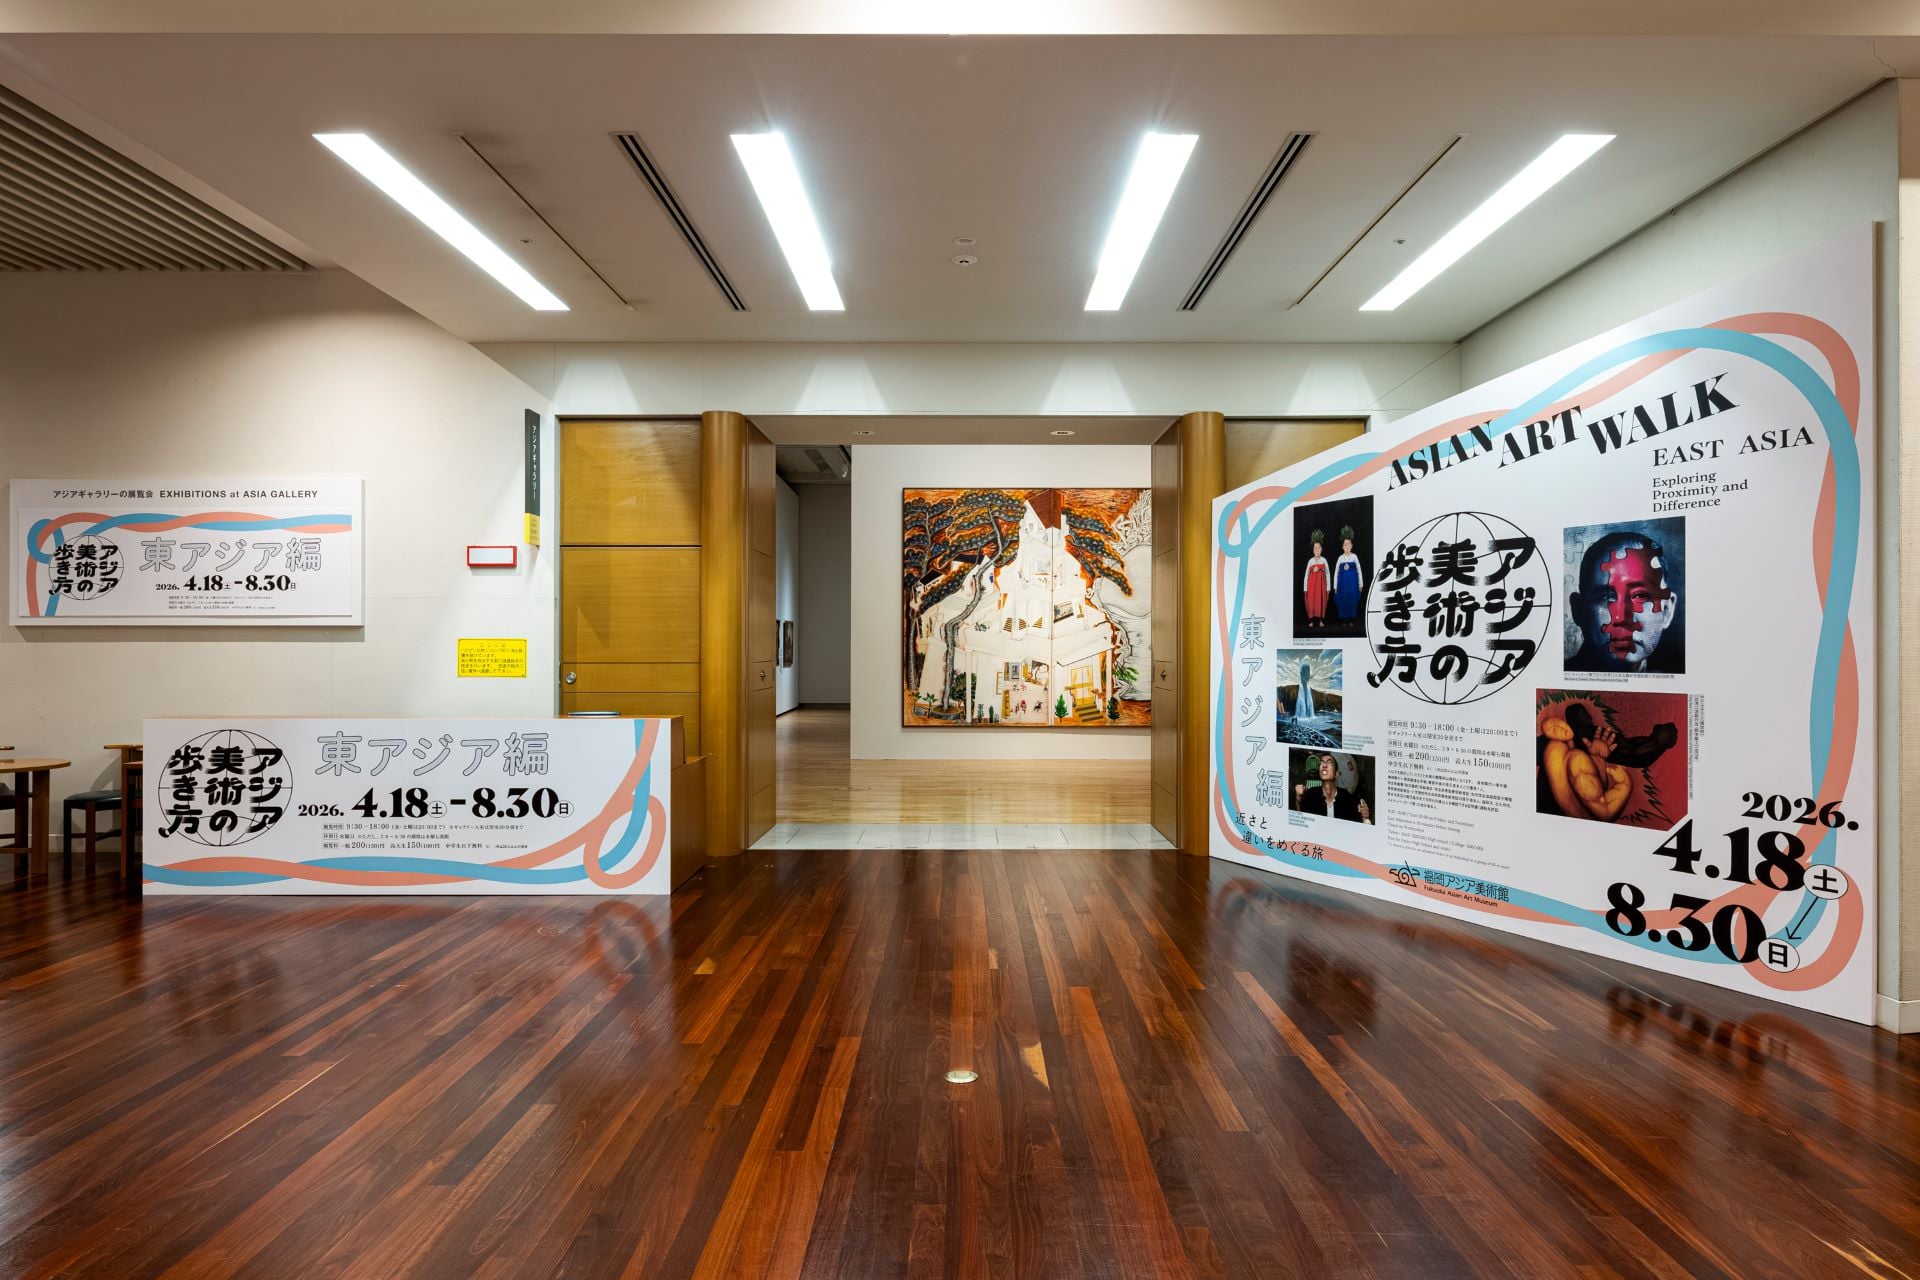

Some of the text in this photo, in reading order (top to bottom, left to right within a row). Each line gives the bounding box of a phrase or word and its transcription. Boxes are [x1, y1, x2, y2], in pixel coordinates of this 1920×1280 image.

[1386, 371, 1741, 492] ASIAN ART WALK
[1652, 425, 1816, 467] EAST ASIA
[53, 489, 154, 499] アジアギャラリーの展覧会
[159, 490, 318, 499] EXHIBITIONS at ASIA GALLERY
[1652, 472, 1717, 488] Exploring
[1652, 479, 1749, 500] Proximity and
[1652, 497, 1721, 513] Difference
[49, 544, 74, 596] 歩き方
[74, 544, 98, 594] 美術の
[99, 544, 120, 595] アジア
[139, 536, 322, 573] 東アジア編
[155, 583, 181, 592] 2026.
[1367, 543, 1424, 688] 歩き方
[1423, 538, 1480, 683] 美術の
[1480, 536, 1537, 685] アジア
[1240, 614, 1284, 808] 東アジア編
[315, 730, 550, 777] 東アジア編
[158, 745, 205, 838] 歩き方
[204, 745, 246, 833] 美術の
[246, 746, 283, 834] アジア
[298, 804, 345, 818] 2026.
[1235, 811, 1268, 830] 近さと
[1741, 792, 1859, 831] 2026.
[1242, 830, 1326, 861] 違いをめぐる旅
[1424, 870, 1510, 903] 福岡アジア美術館
[1424, 885, 1498, 907] Fukuoka Asian Art Museum
